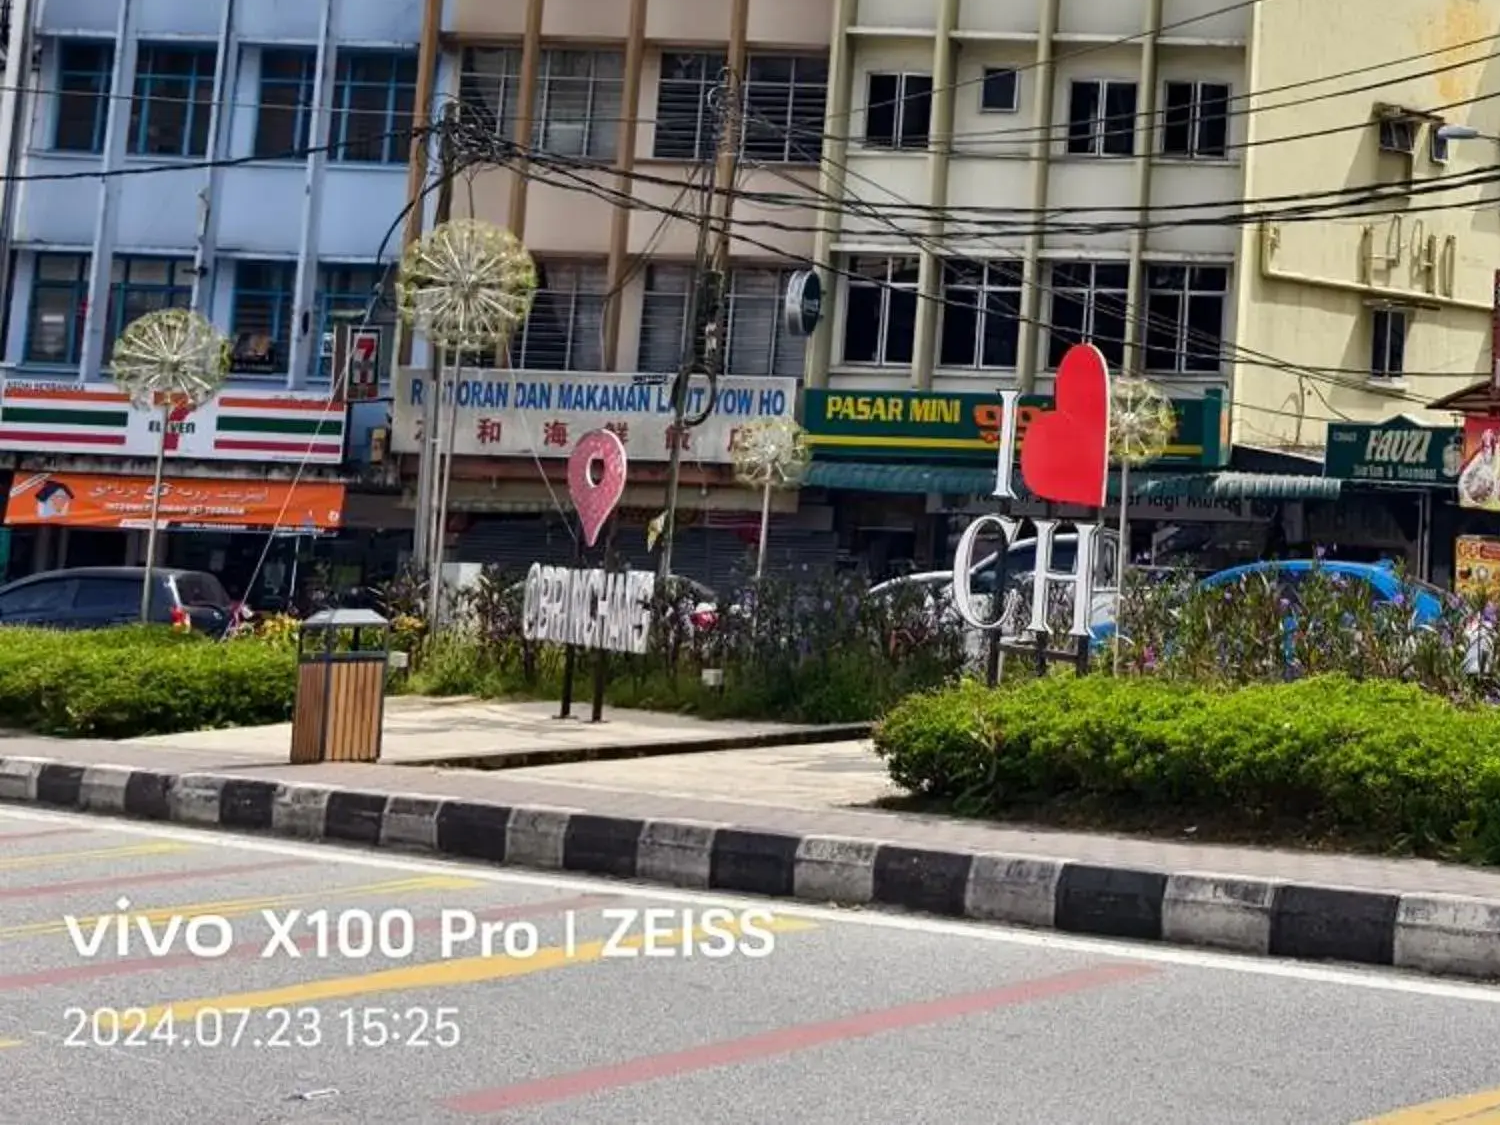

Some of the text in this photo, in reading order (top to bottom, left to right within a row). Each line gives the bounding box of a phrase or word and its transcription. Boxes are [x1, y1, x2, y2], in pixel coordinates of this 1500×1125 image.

[411, 378, 508, 408] RTORAN
[515, 382, 551, 409] DAN
[558, 383, 650, 412] MAKANAN
[714, 387, 754, 414] YOW
[759, 389, 785, 416] HO
[826, 395, 961, 424] PASAR MINI
[954, 514, 1104, 638] CH
